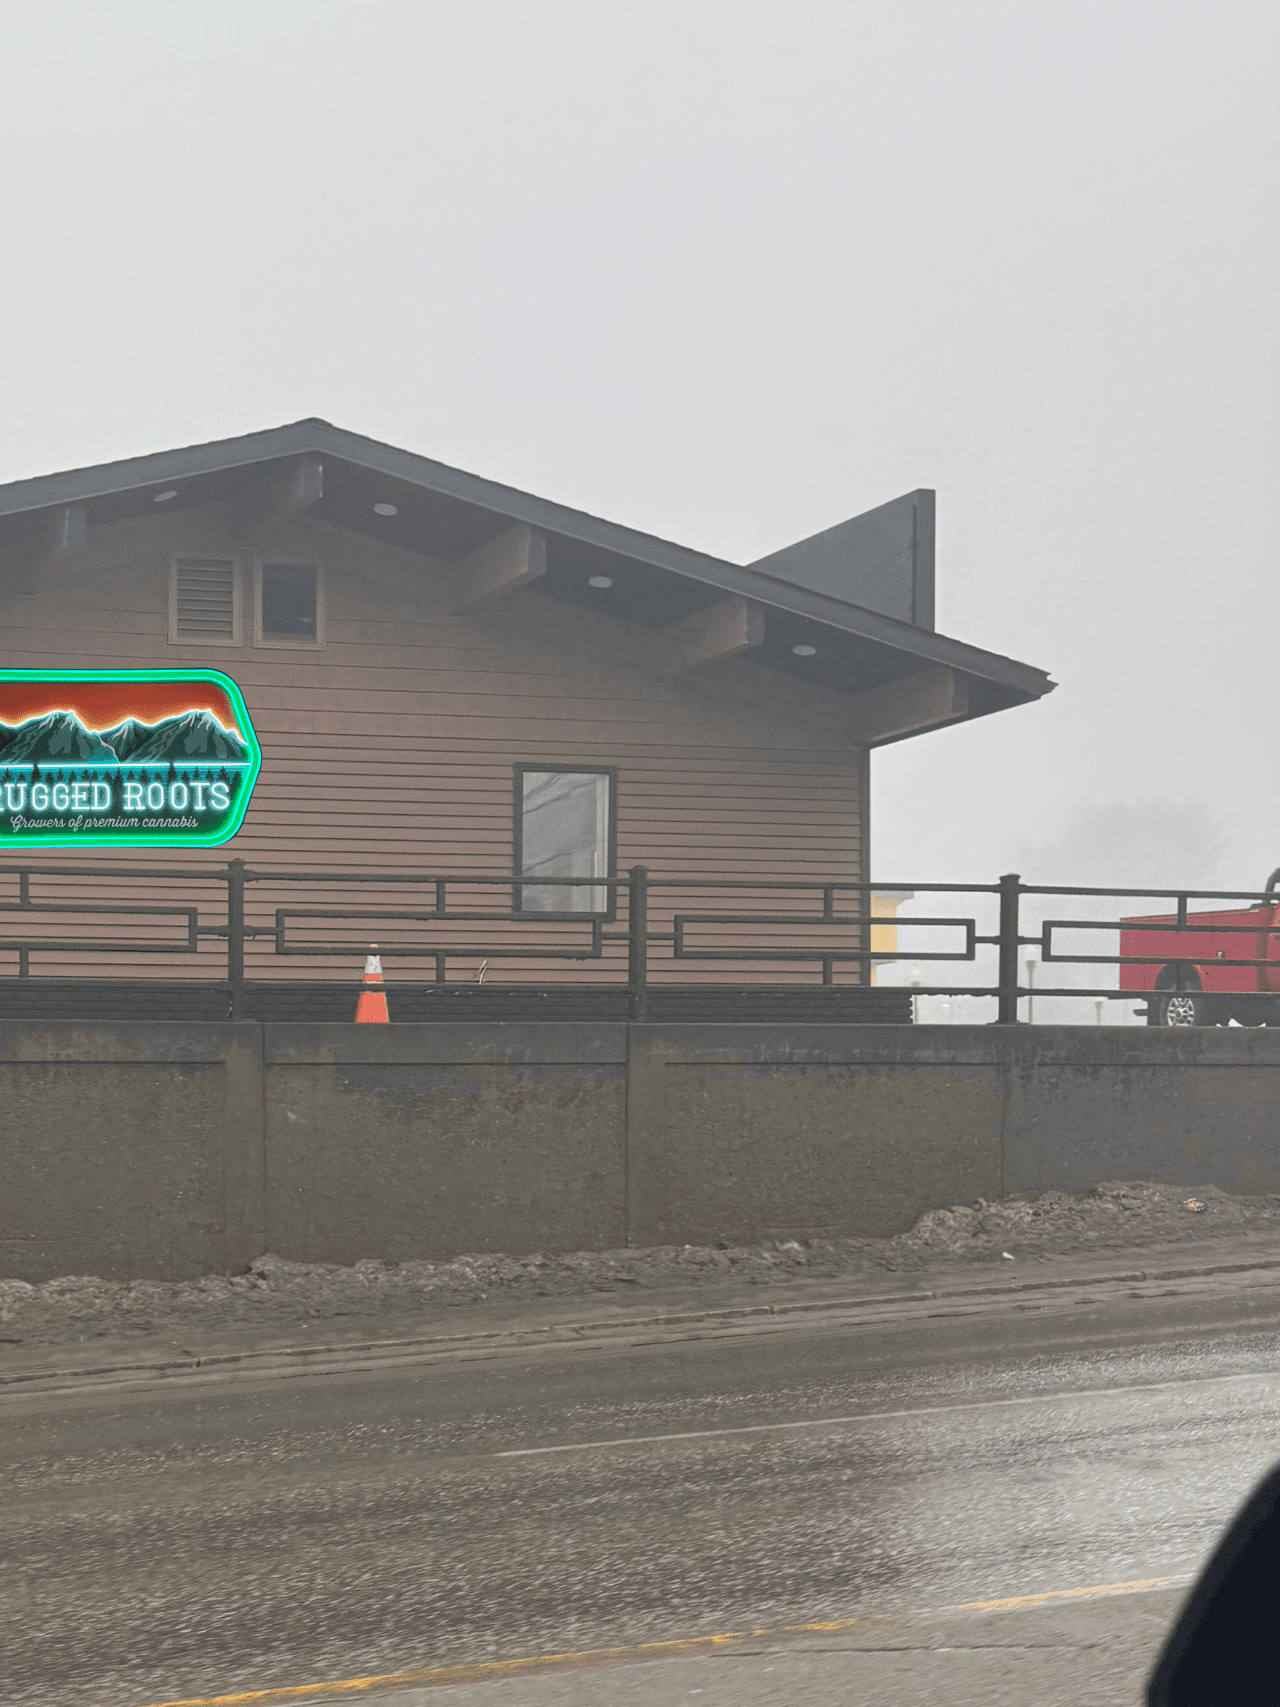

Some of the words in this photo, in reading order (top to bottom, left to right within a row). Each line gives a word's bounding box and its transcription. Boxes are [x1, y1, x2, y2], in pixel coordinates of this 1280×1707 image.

[123, 782, 231, 810] ROOTS
[10, 815, 66, 832] Growers
[67, 815, 83, 831] of
[83, 816, 140, 829] premium
[141, 815, 199, 828] cannabis
